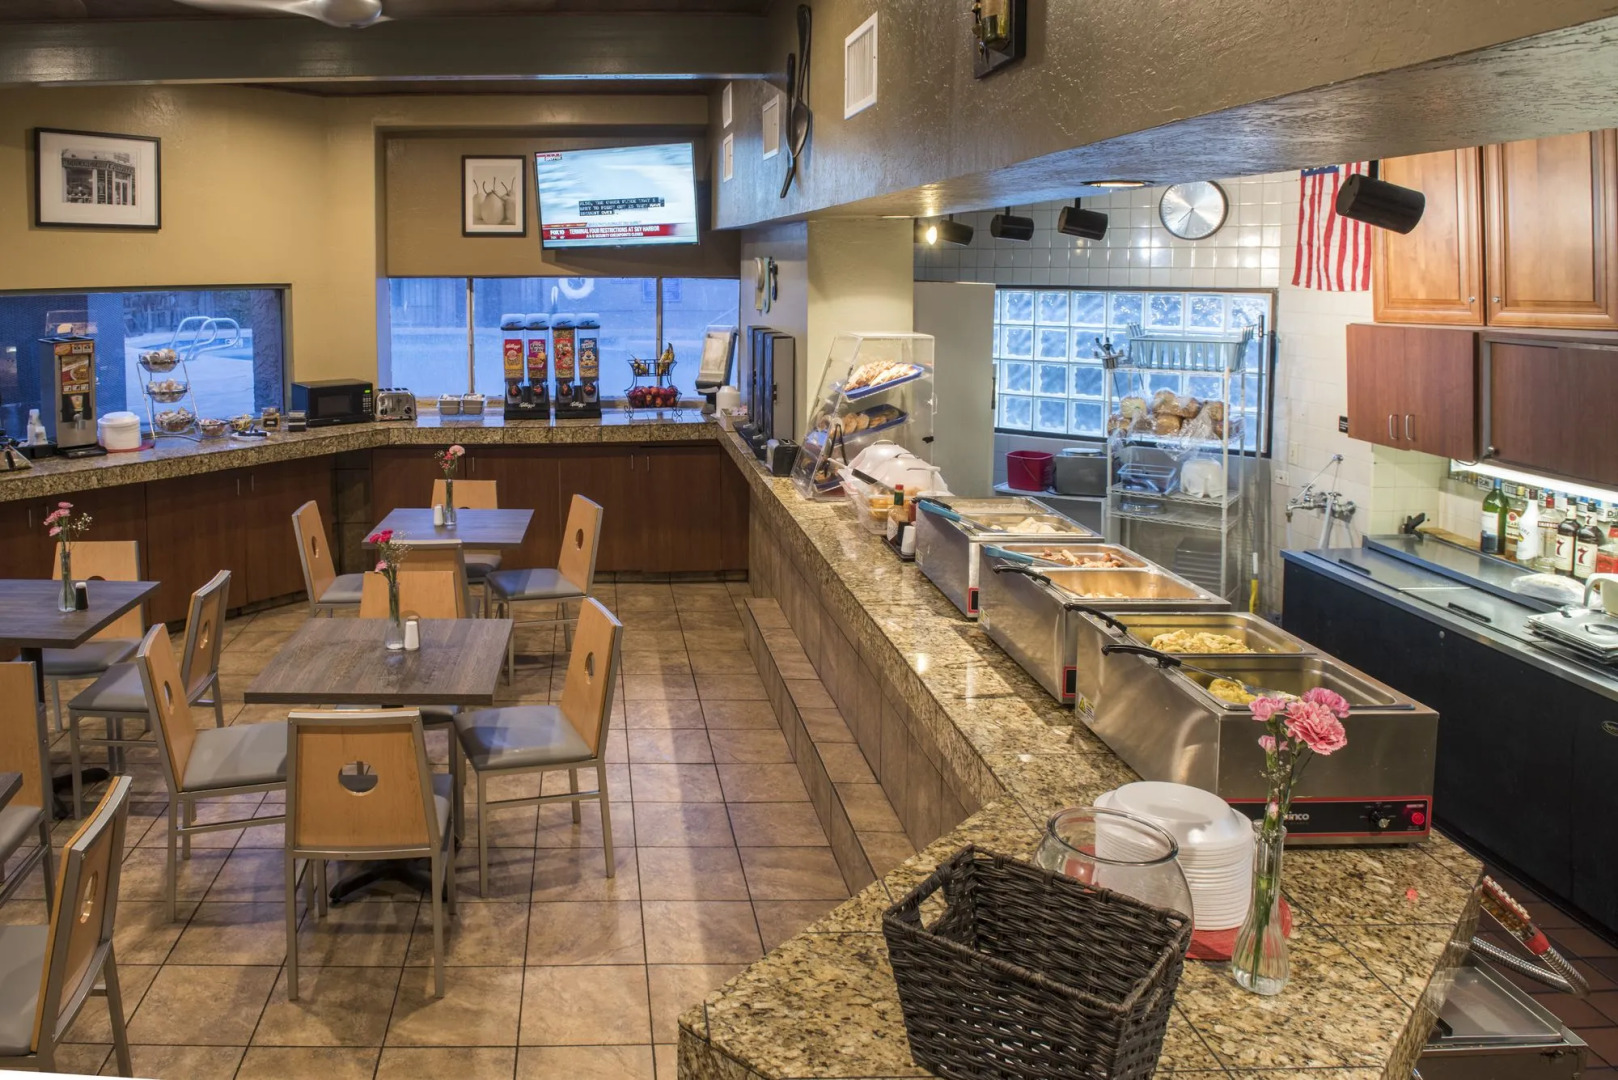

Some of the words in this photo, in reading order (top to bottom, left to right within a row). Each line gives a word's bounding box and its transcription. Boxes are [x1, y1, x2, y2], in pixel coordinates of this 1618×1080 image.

[1585, 514, 1592, 524] 7
[1556, 540, 1564, 555] 7
[1577, 547, 1588, 564] 7
